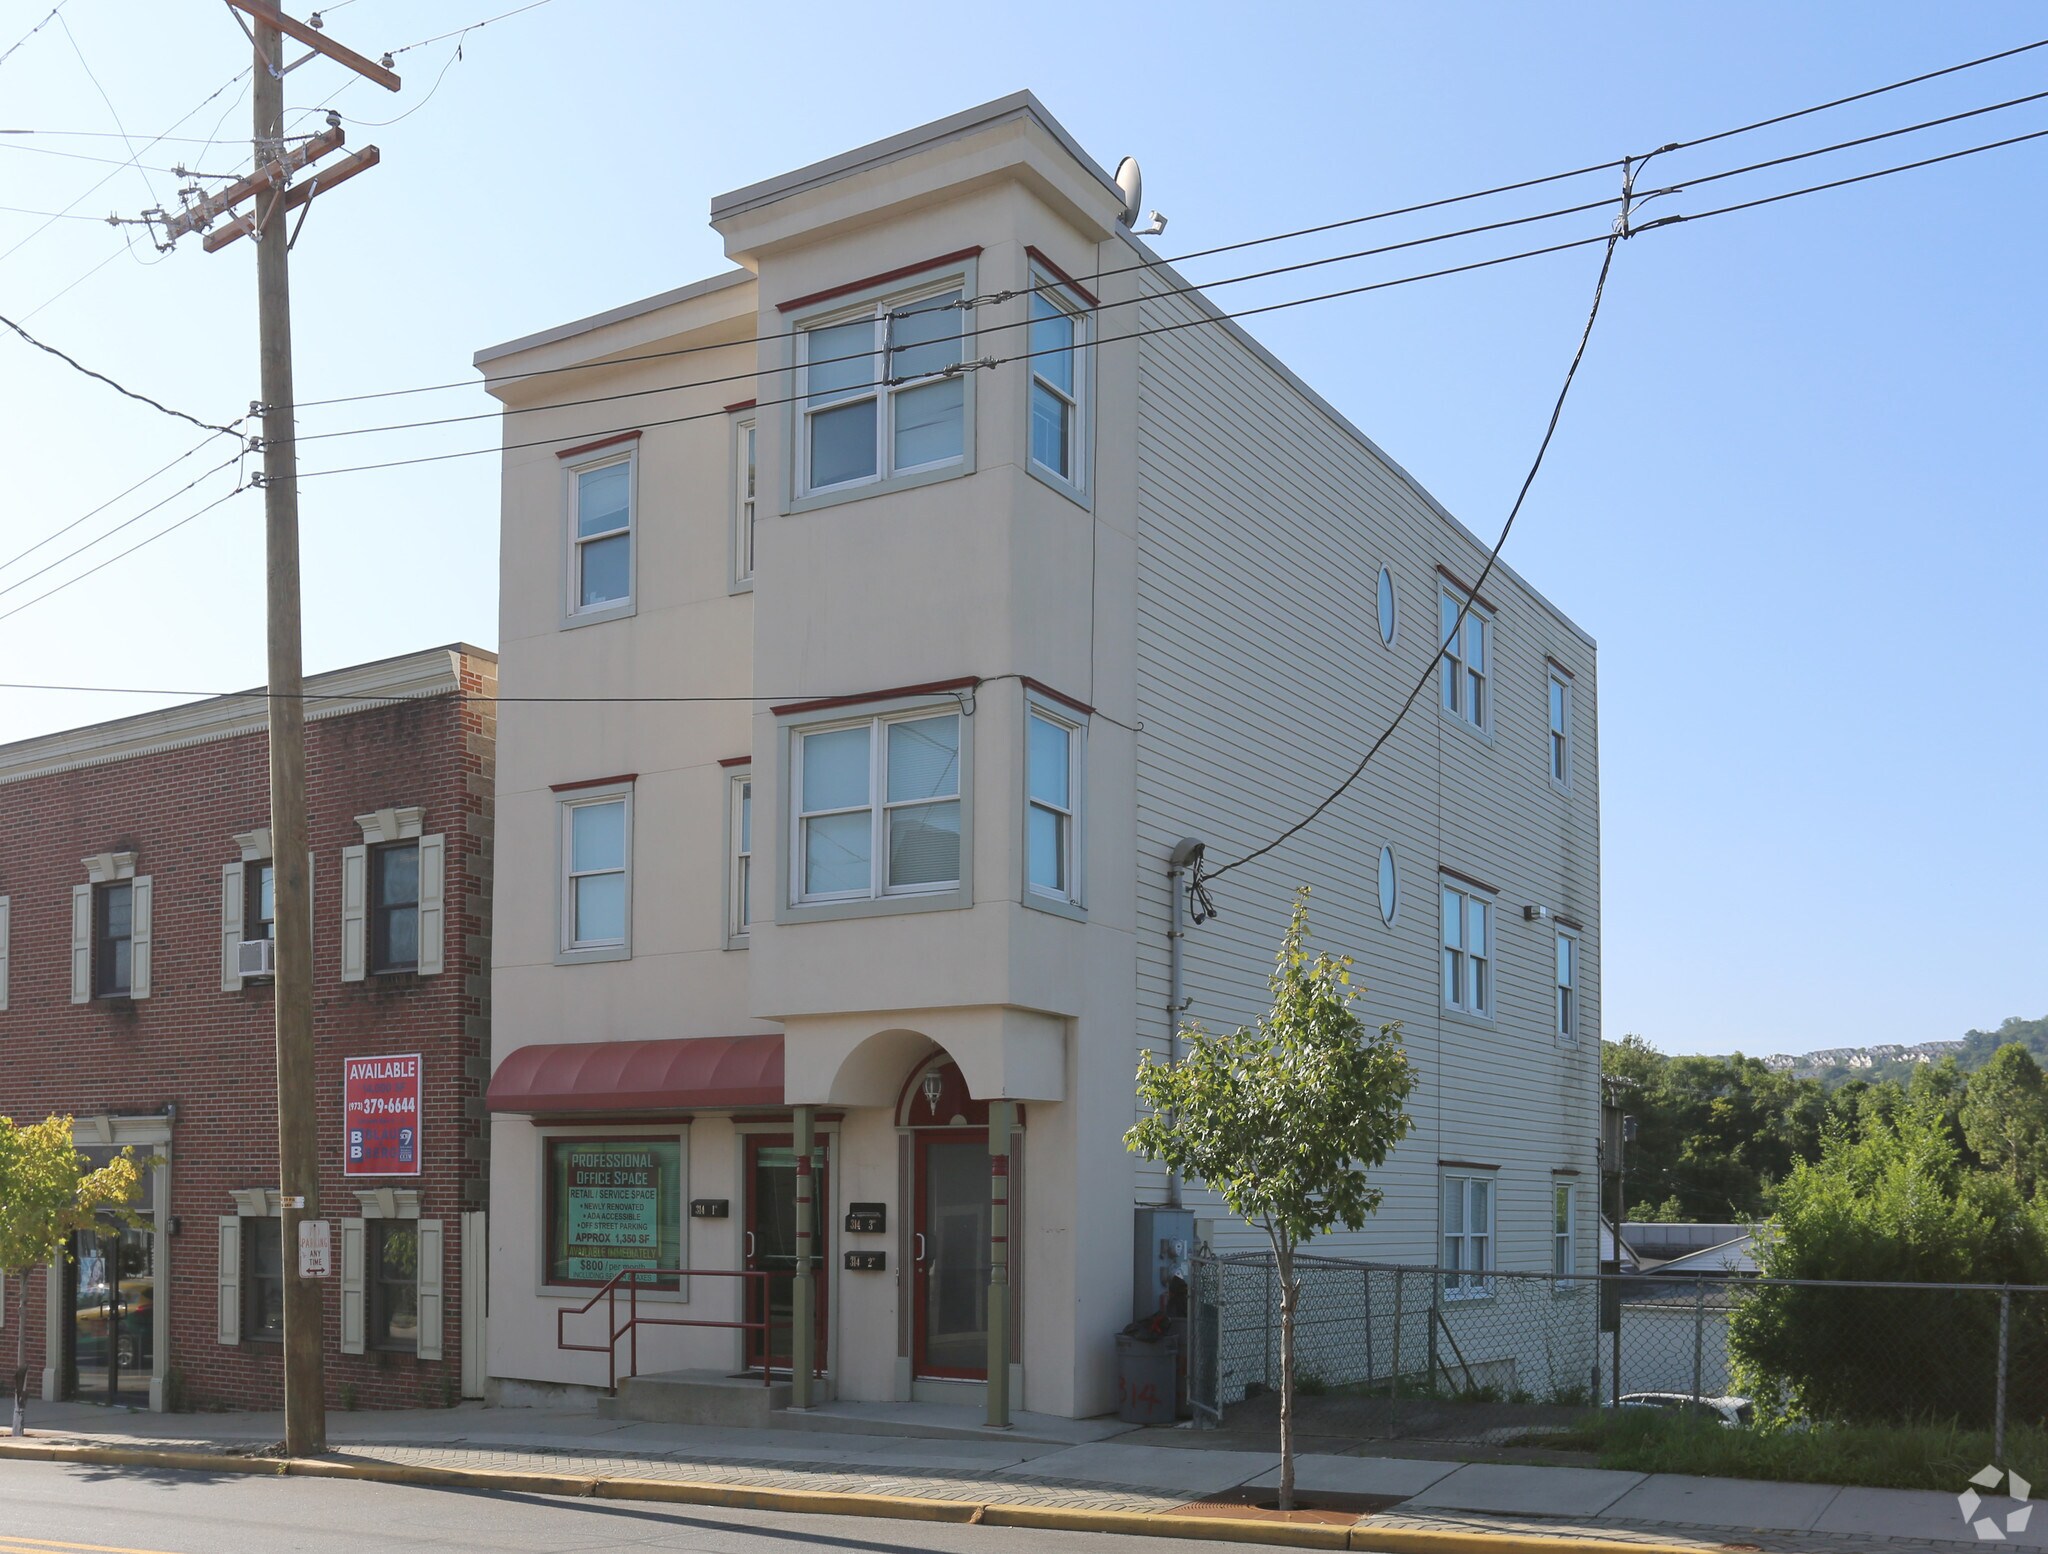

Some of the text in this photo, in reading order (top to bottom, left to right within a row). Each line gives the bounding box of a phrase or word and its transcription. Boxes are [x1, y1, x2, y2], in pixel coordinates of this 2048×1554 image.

[350, 1061, 415, 1080] AVAILABLE
[348, 1097, 415, 1114] (973) 379-6644
[351, 1131, 362, 1144] B
[366, 1129, 397, 1140] BLAU
[351, 1145, 362, 1159] B
[572, 1154, 654, 1168] PROFESSIONAL
[576, 1170, 648, 1185] OFFICE SPACE
[570, 1189, 594, 1199] RETAIL
[599, 1189, 630, 1199] SERVICE
[631, 1189, 655, 1200] SPACE
[584, 1202, 644, 1211] NEWLY RENOVATED
[695, 1204, 705, 1215] 314
[587, 1212, 602, 1220] ADA
[580, 1222, 648, 1231] OFF STREET PARKING
[849, 1219, 861, 1230] 314
[575, 1232, 650, 1244] APPROX 1,350 SF
[569, 1247, 657, 1258] AVAILABLE IMMEDIATELY
[580, 1259, 603, 1271] $800
[609, 1263, 621, 1271] per
[849, 1256, 860, 1267] 314
[1119, 1376, 1161, 1415] 314
